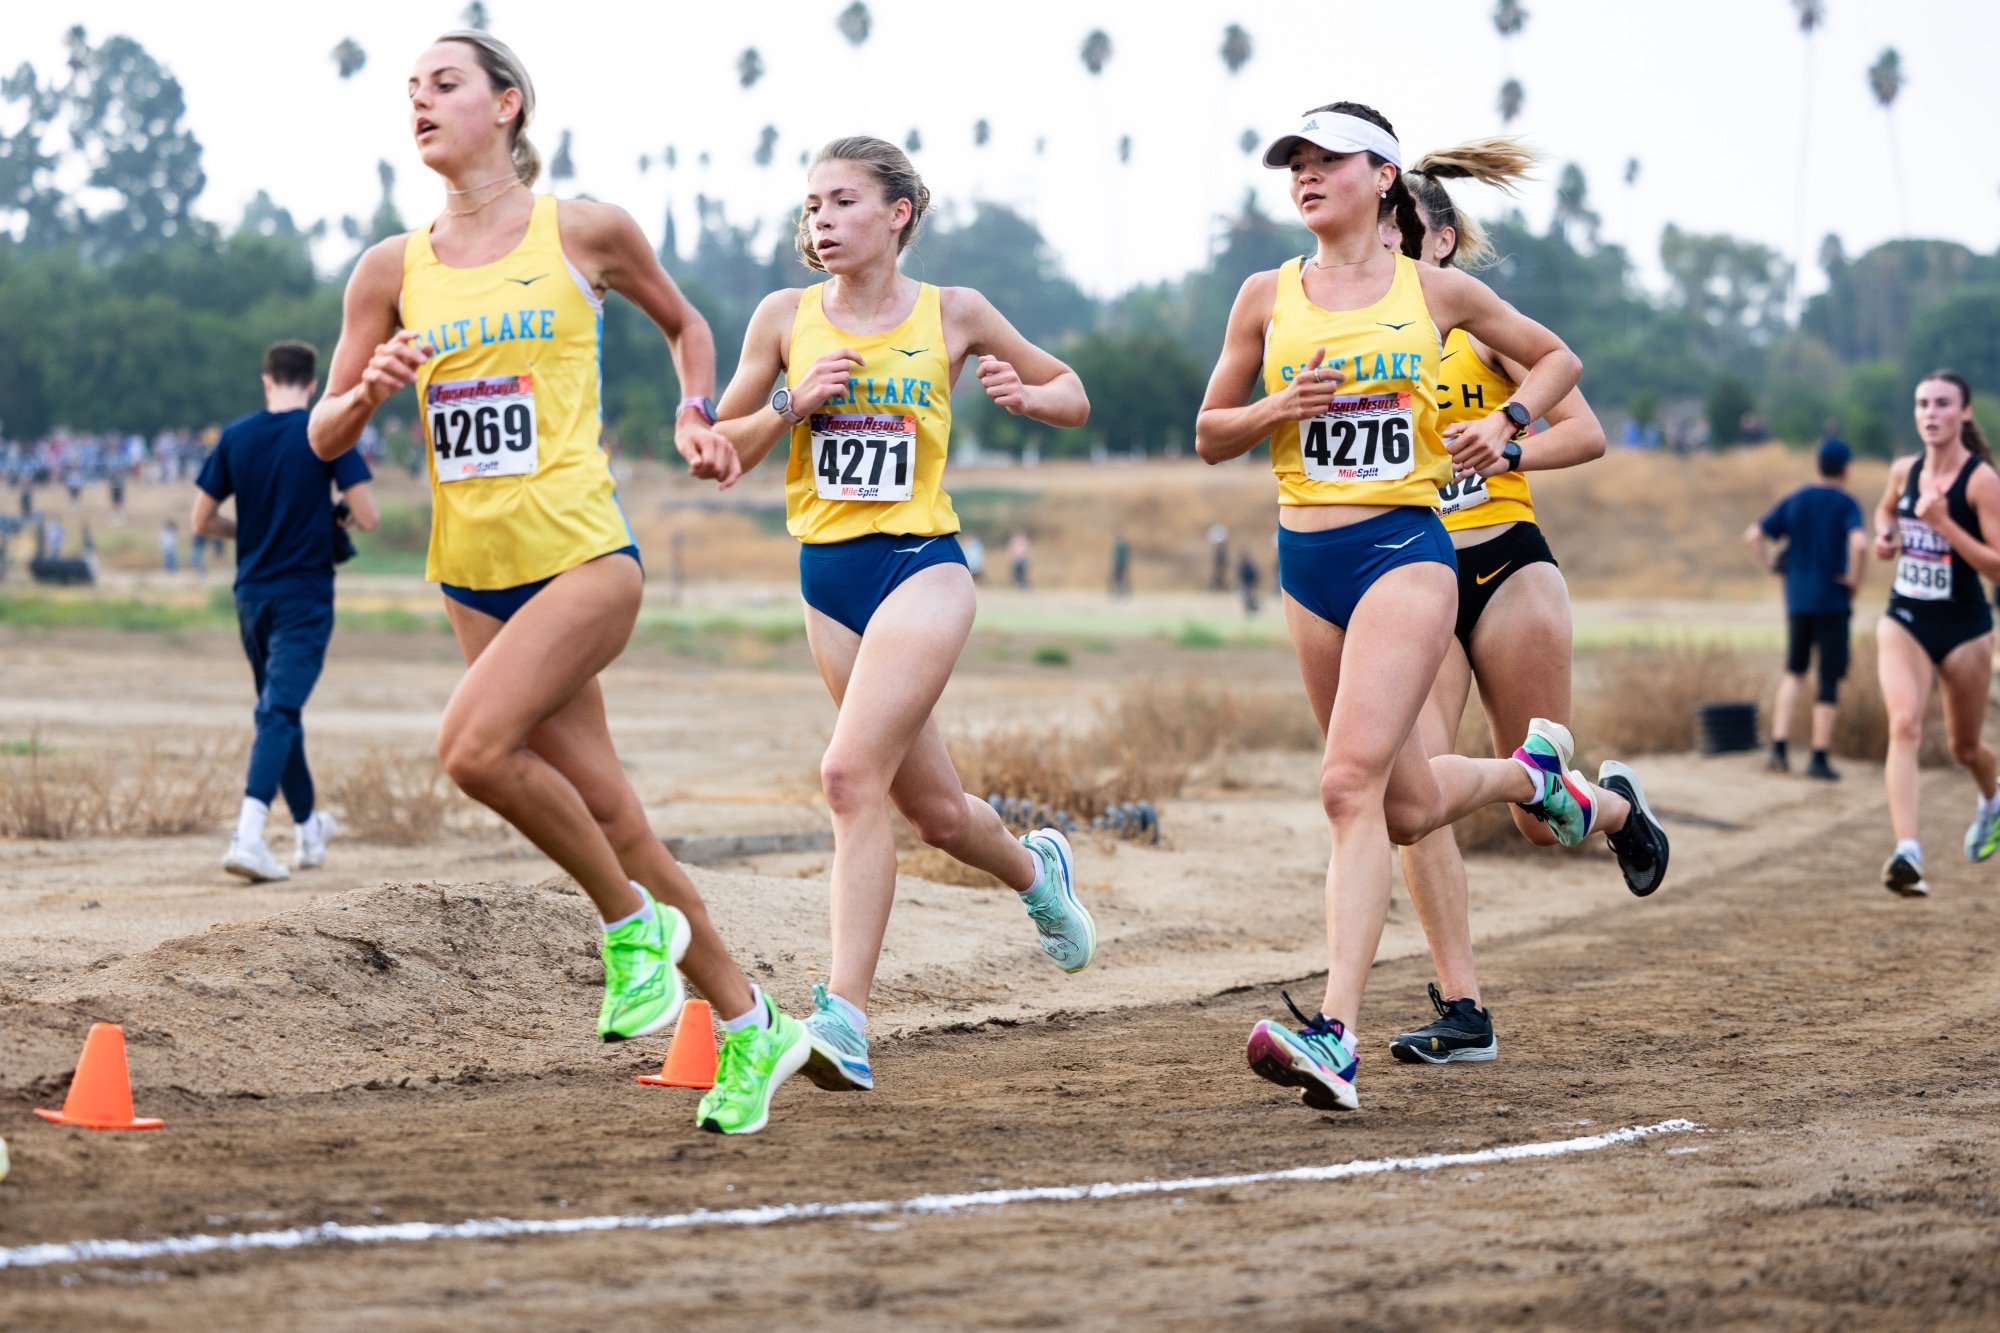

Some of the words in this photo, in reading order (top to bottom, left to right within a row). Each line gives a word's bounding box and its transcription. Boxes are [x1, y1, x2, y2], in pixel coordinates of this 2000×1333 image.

[479, 309, 555, 345] LAKE
[1281, 357, 1346, 384] ST
[1353, 352, 1422, 382] LAKE
[866, 377, 932, 408] LAKE
[434, 404, 532, 459] 4269
[1304, 417, 1410, 466] 4276
[818, 438, 909, 486] 4271
[1338, 467, 1379, 479] MileSplit
[841, 487, 879, 498] MileSplit
